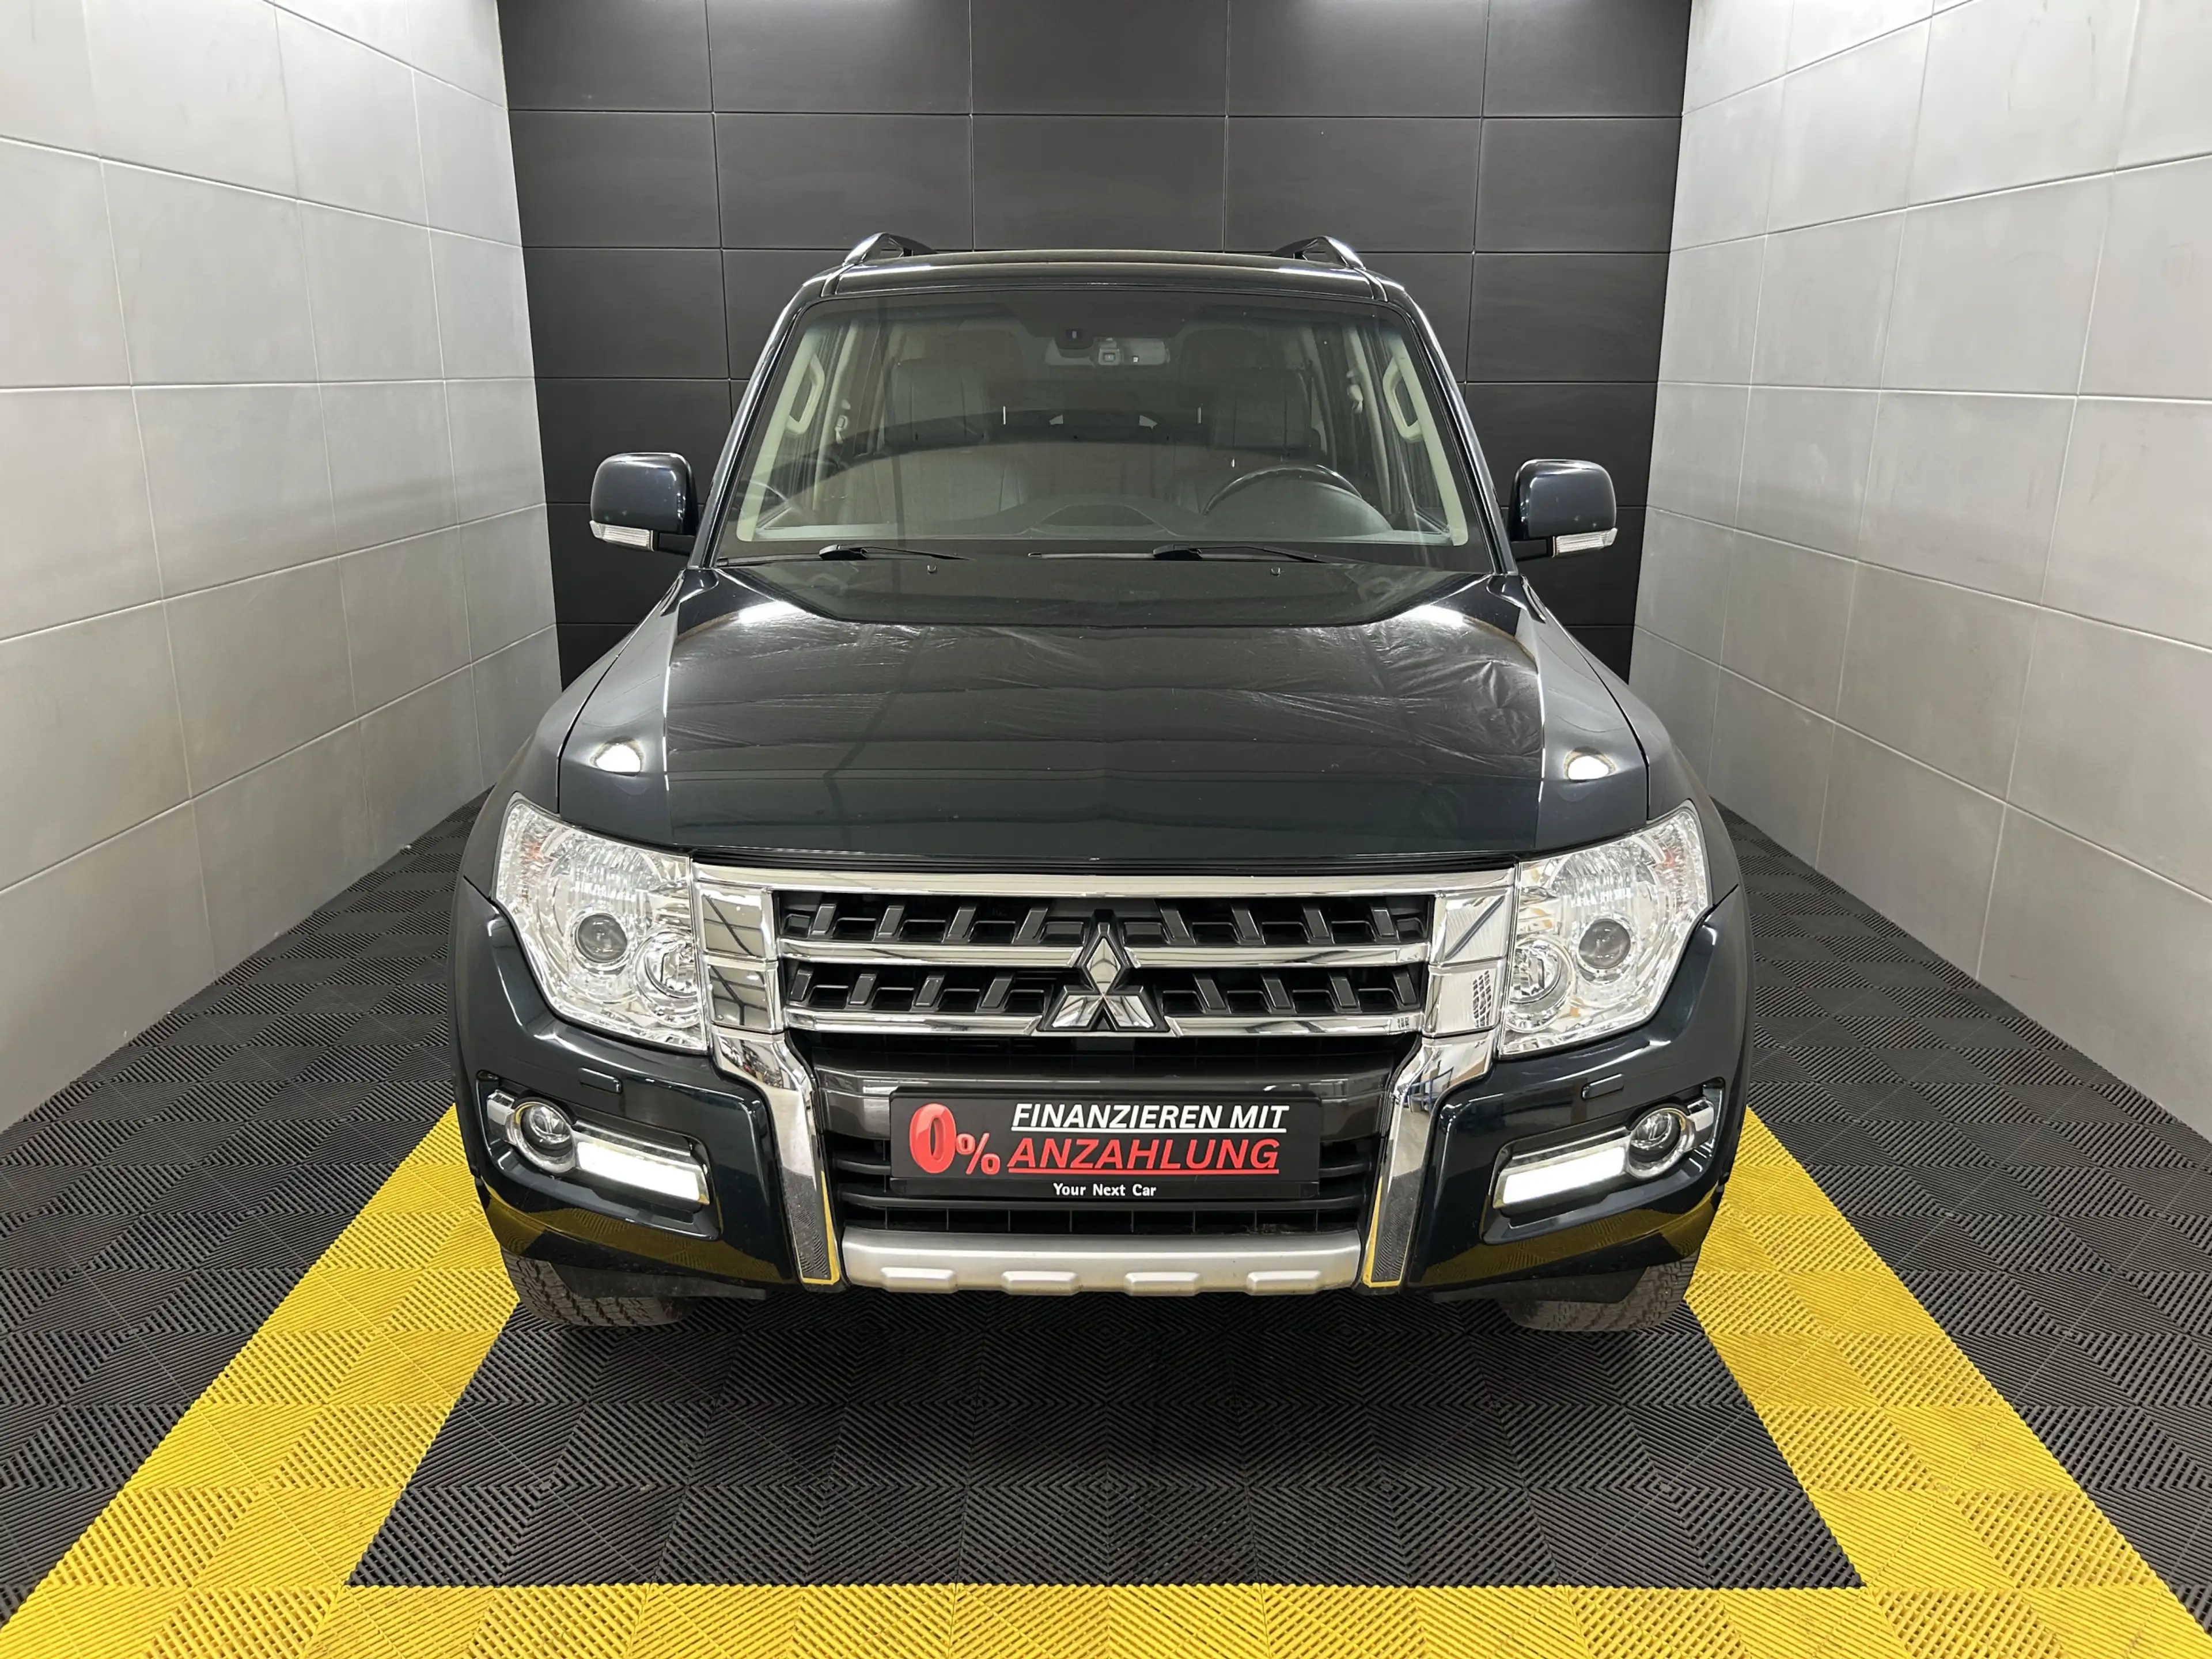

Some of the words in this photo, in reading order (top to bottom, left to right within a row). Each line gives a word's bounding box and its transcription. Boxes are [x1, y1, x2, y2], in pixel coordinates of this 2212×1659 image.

[1012, 1103, 1223, 1128] FINANZIEREN
[1229, 1105, 1290, 1128] MIT
[909, 1103, 1001, 1175] 0%
[1007, 1138, 1279, 1169] ANZAHLUNG
[1053, 1183, 1086, 1196] Your
[1093, 1183, 1126, 1196] Next
[1132, 1184, 1157, 1196] Car
